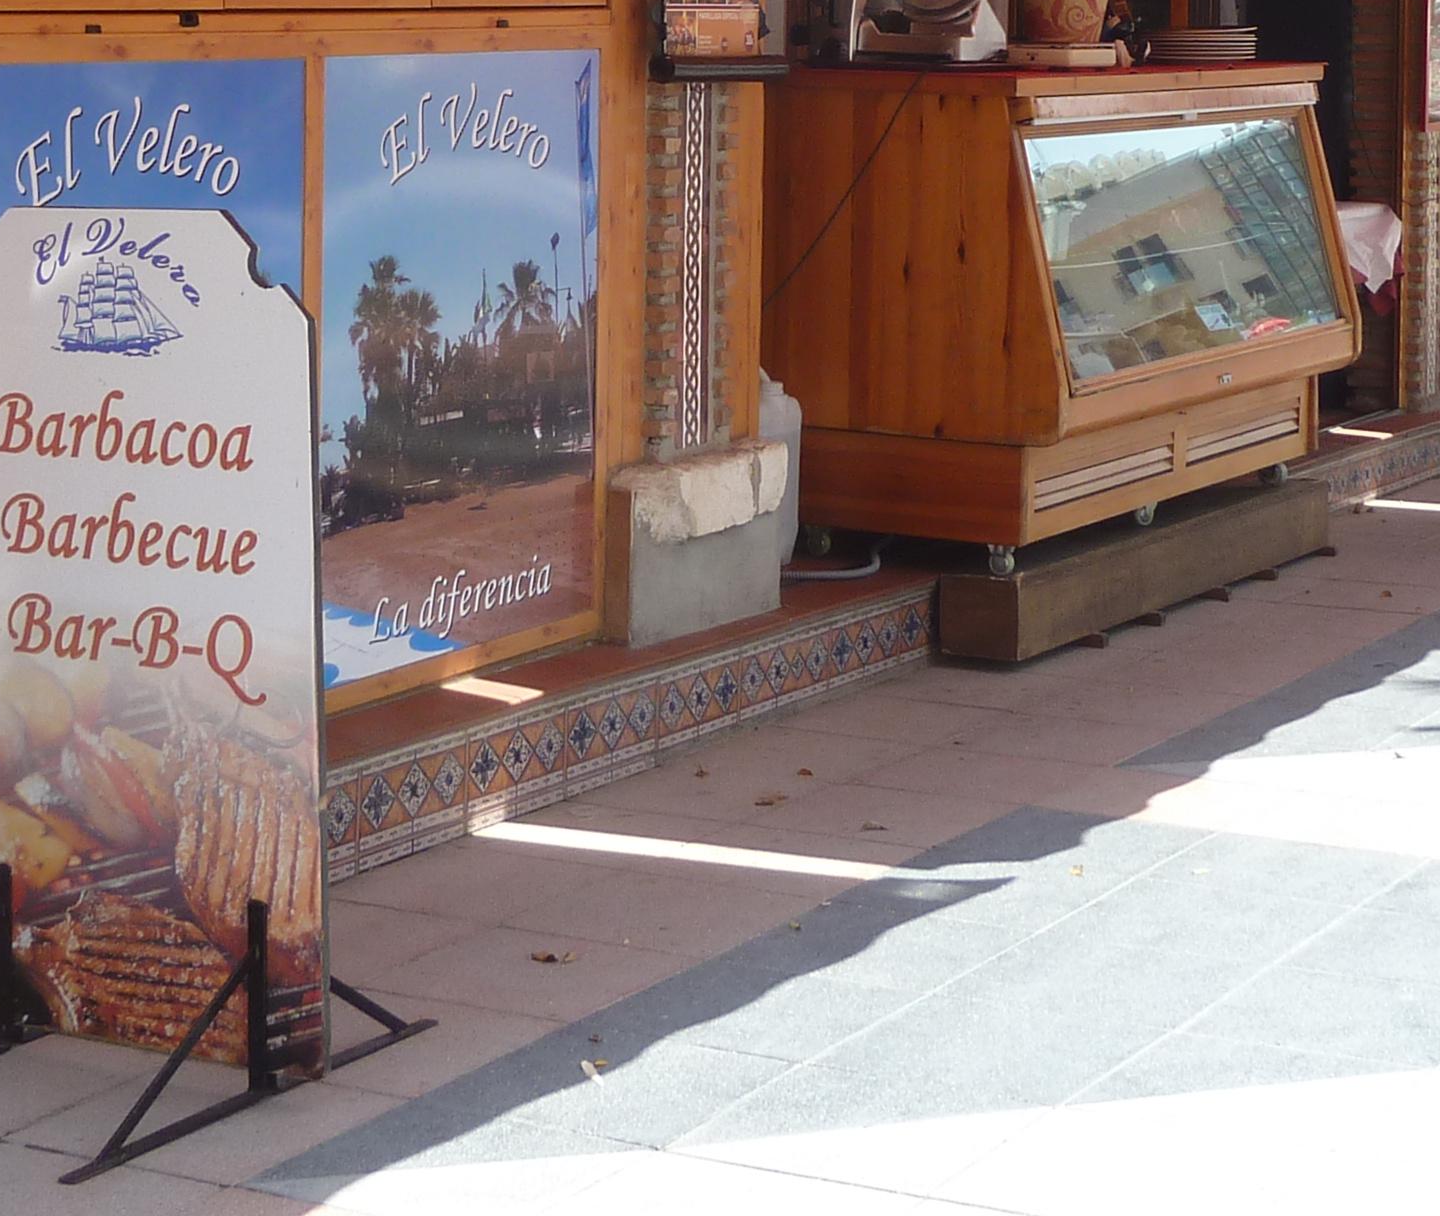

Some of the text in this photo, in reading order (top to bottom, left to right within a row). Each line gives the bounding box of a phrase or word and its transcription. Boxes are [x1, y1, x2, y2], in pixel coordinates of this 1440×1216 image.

[15, 95, 243, 208] El Velero
[377, 82, 553, 187] El Velero
[32, 216, 204, 308] El Velero
[0, 492, 259, 575] Barbecue
[368, 553, 553, 645] La diferencia
[6, 591, 268, 706] Bar-B-Q
